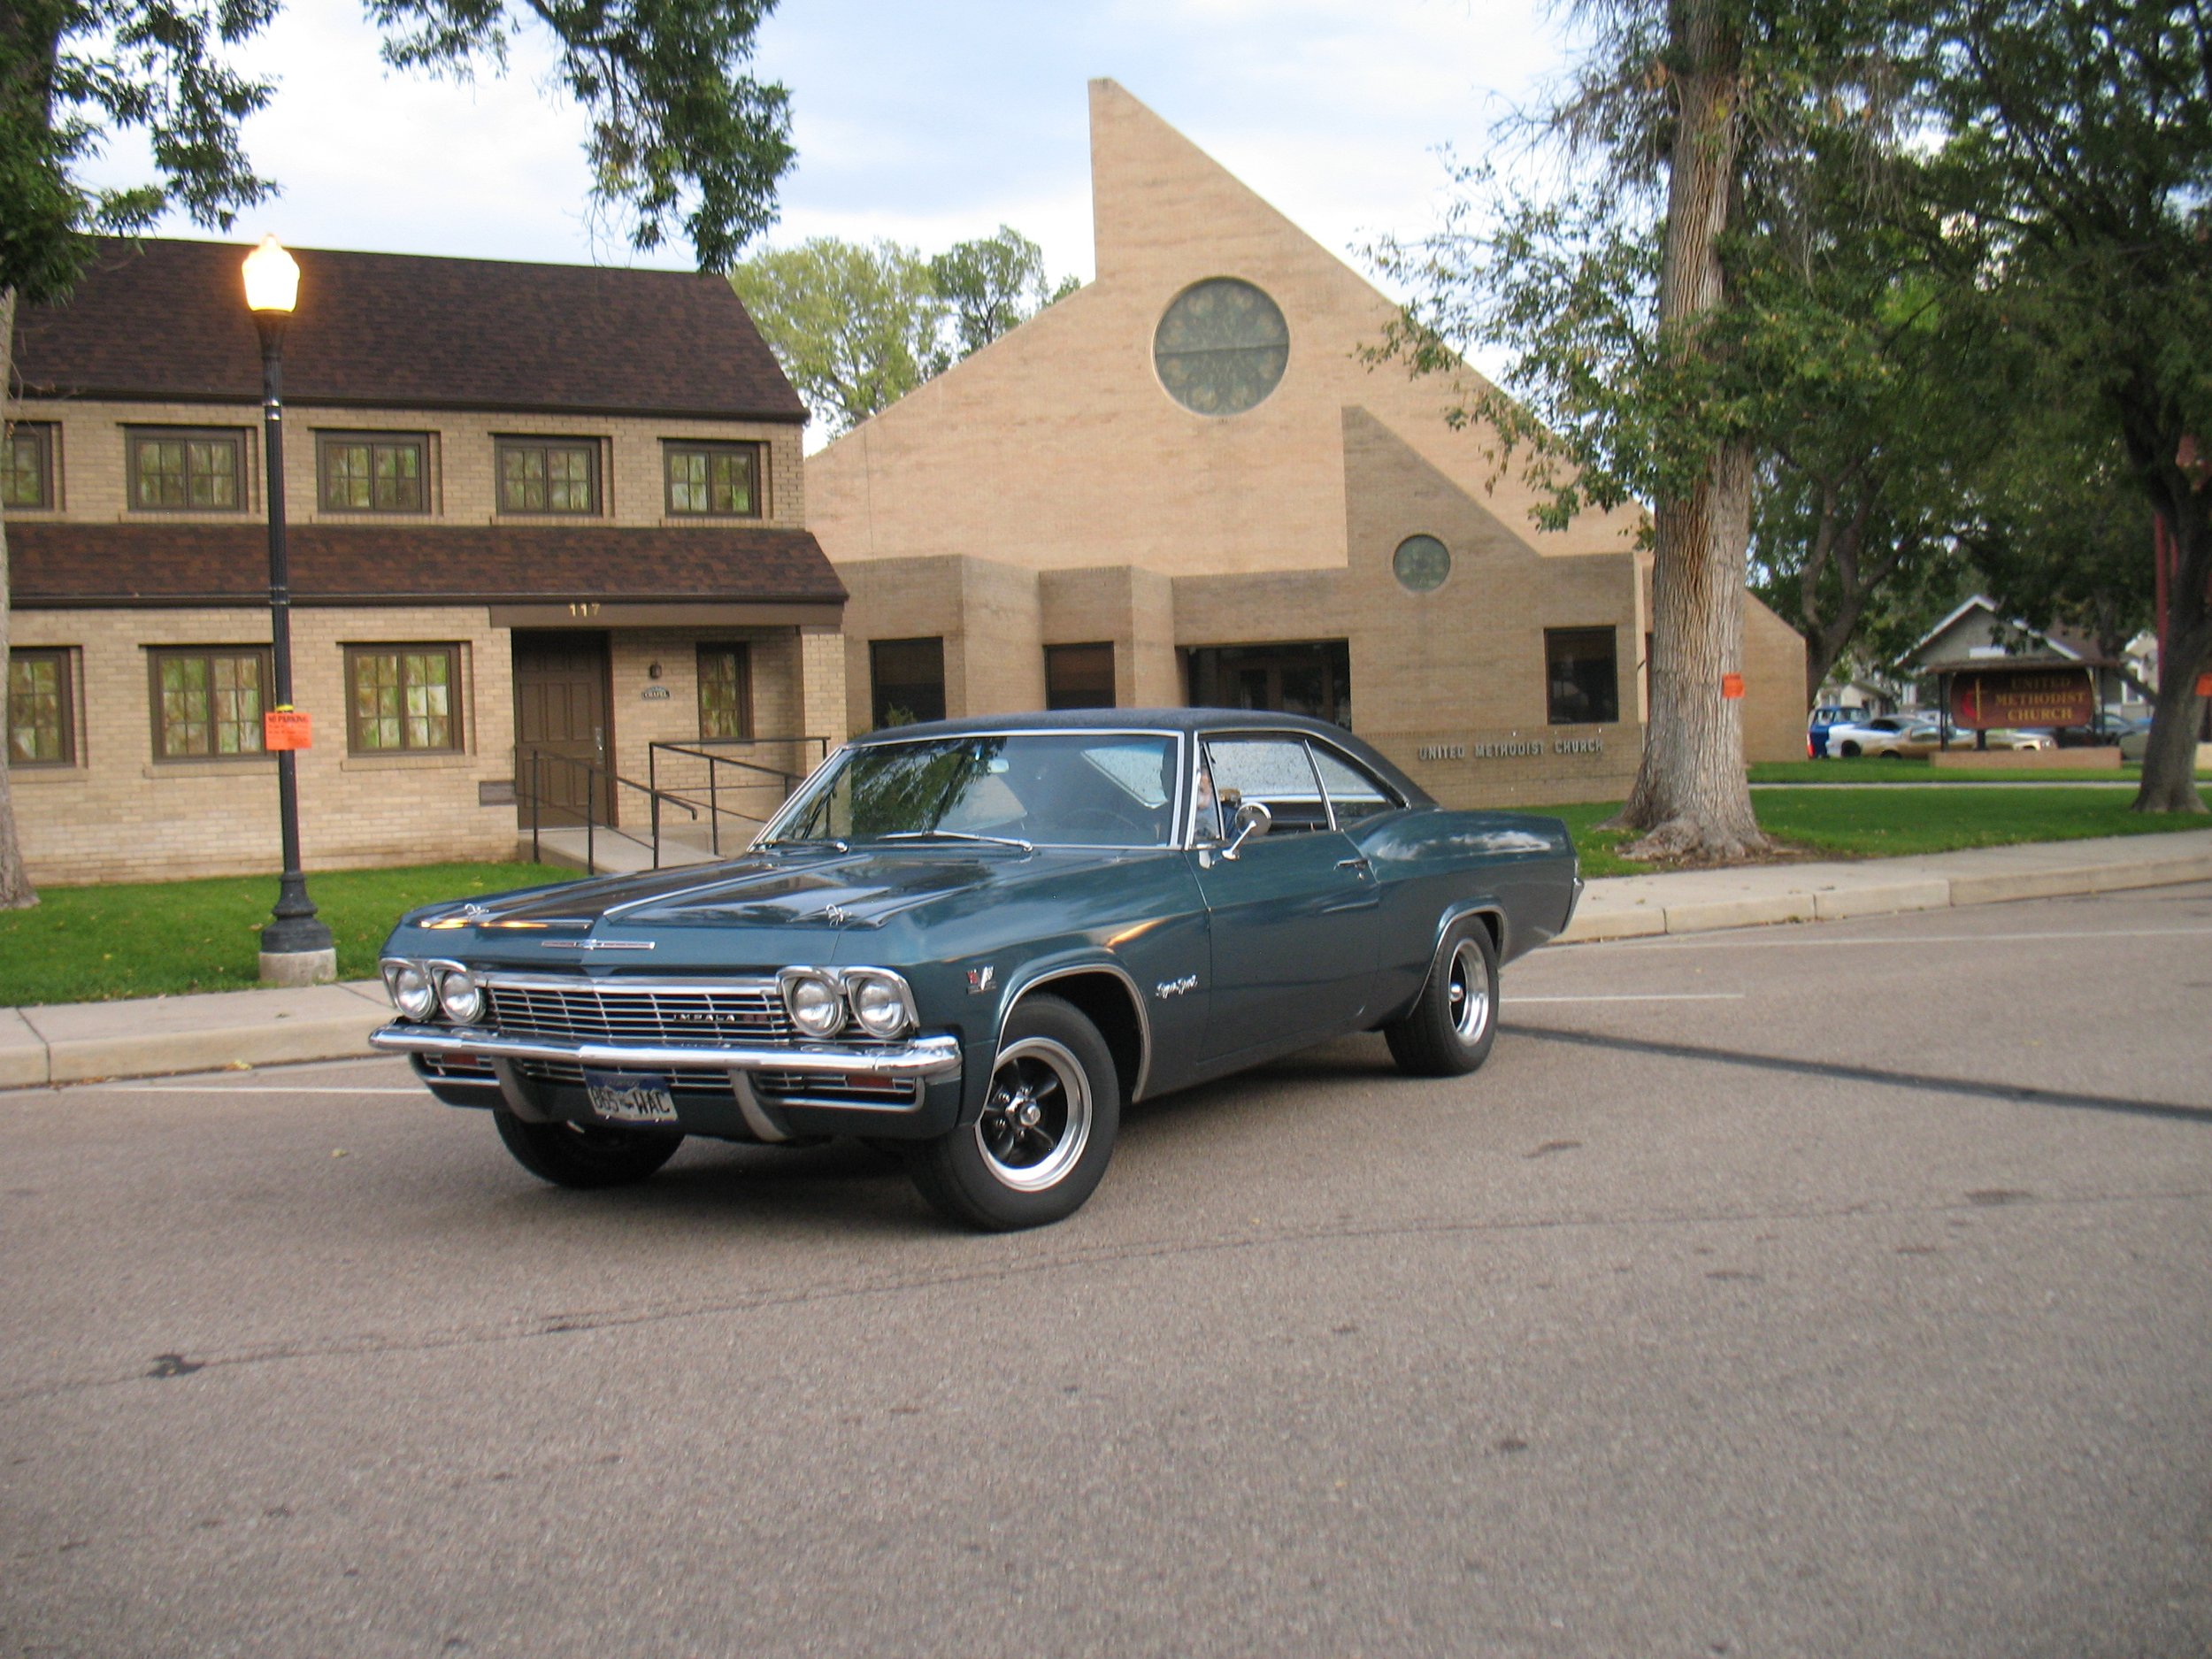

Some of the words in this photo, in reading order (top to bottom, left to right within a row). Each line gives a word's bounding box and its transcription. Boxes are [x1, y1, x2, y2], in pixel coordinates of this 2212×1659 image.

[569, 603, 601, 617] 117
[2011, 677, 2071, 690] UNITED
[1995, 692, 2085, 706] METHODIST
[2008, 708, 2073, 721] CHURCH
[1418, 744, 1465, 760] UNITED
[1475, 741, 1545, 758] METHODIST
[1554, 737, 1604, 753] CHURCH
[673, 1013, 735, 1022] IMPALA
